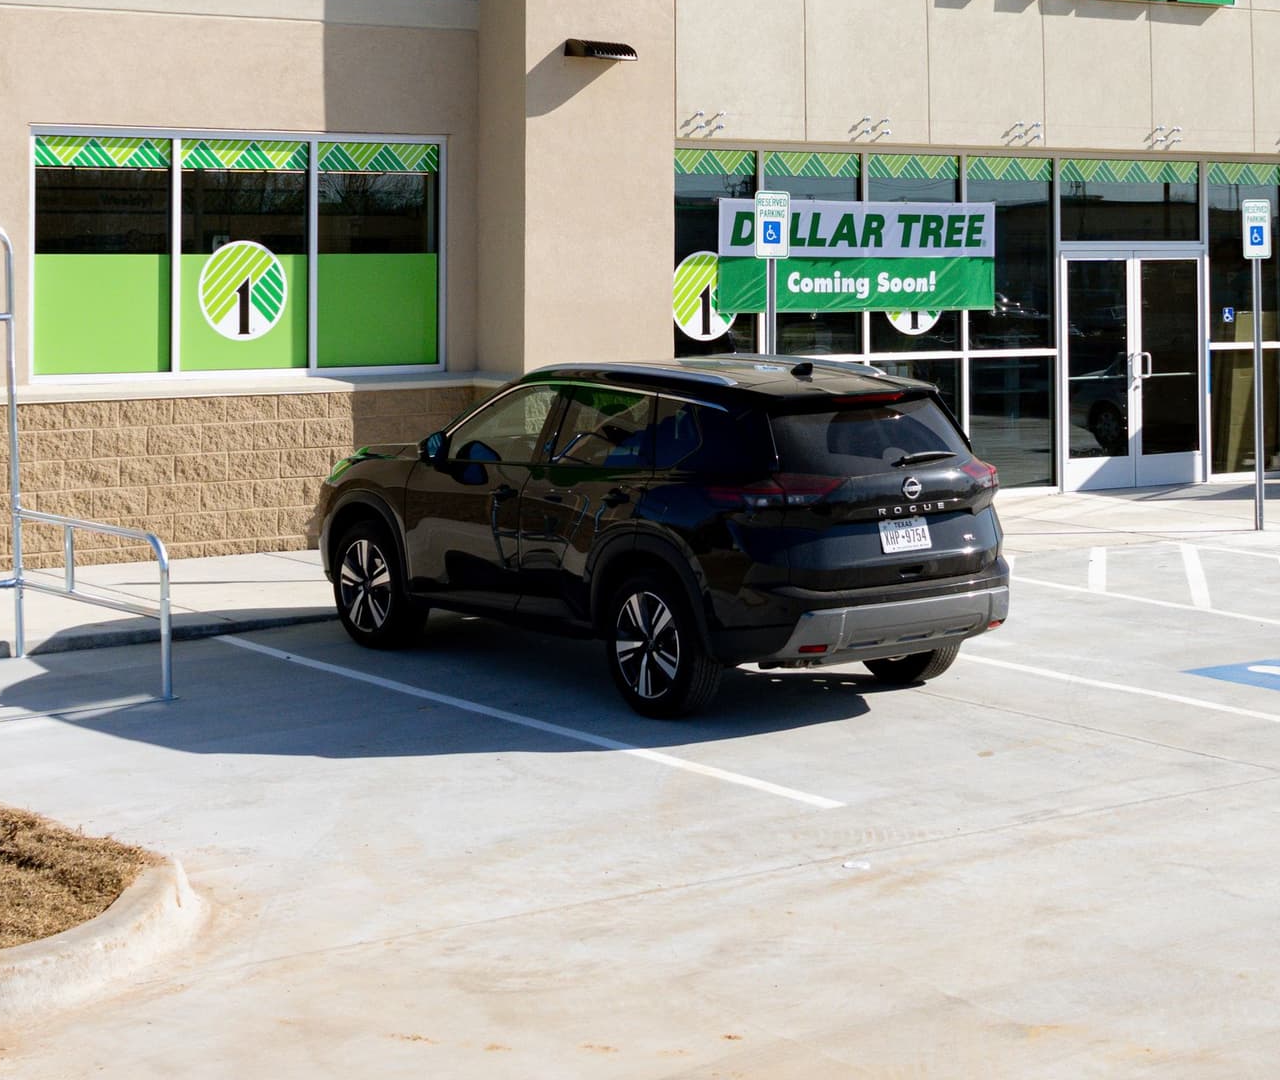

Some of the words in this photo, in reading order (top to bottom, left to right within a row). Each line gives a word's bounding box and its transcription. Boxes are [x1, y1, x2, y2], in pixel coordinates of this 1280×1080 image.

[757, 198, 788, 207] RESERVED
[760, 209, 785, 218] PARKING
[730, 211, 885, 248] DLLAR
[897, 214, 986, 248] TREE
[787, 271, 870, 299] Coming
[877, 271, 937, 293] Soon!
[878, 502, 946, 516] ROGUE
[894, 520, 913, 528] TEXAS
